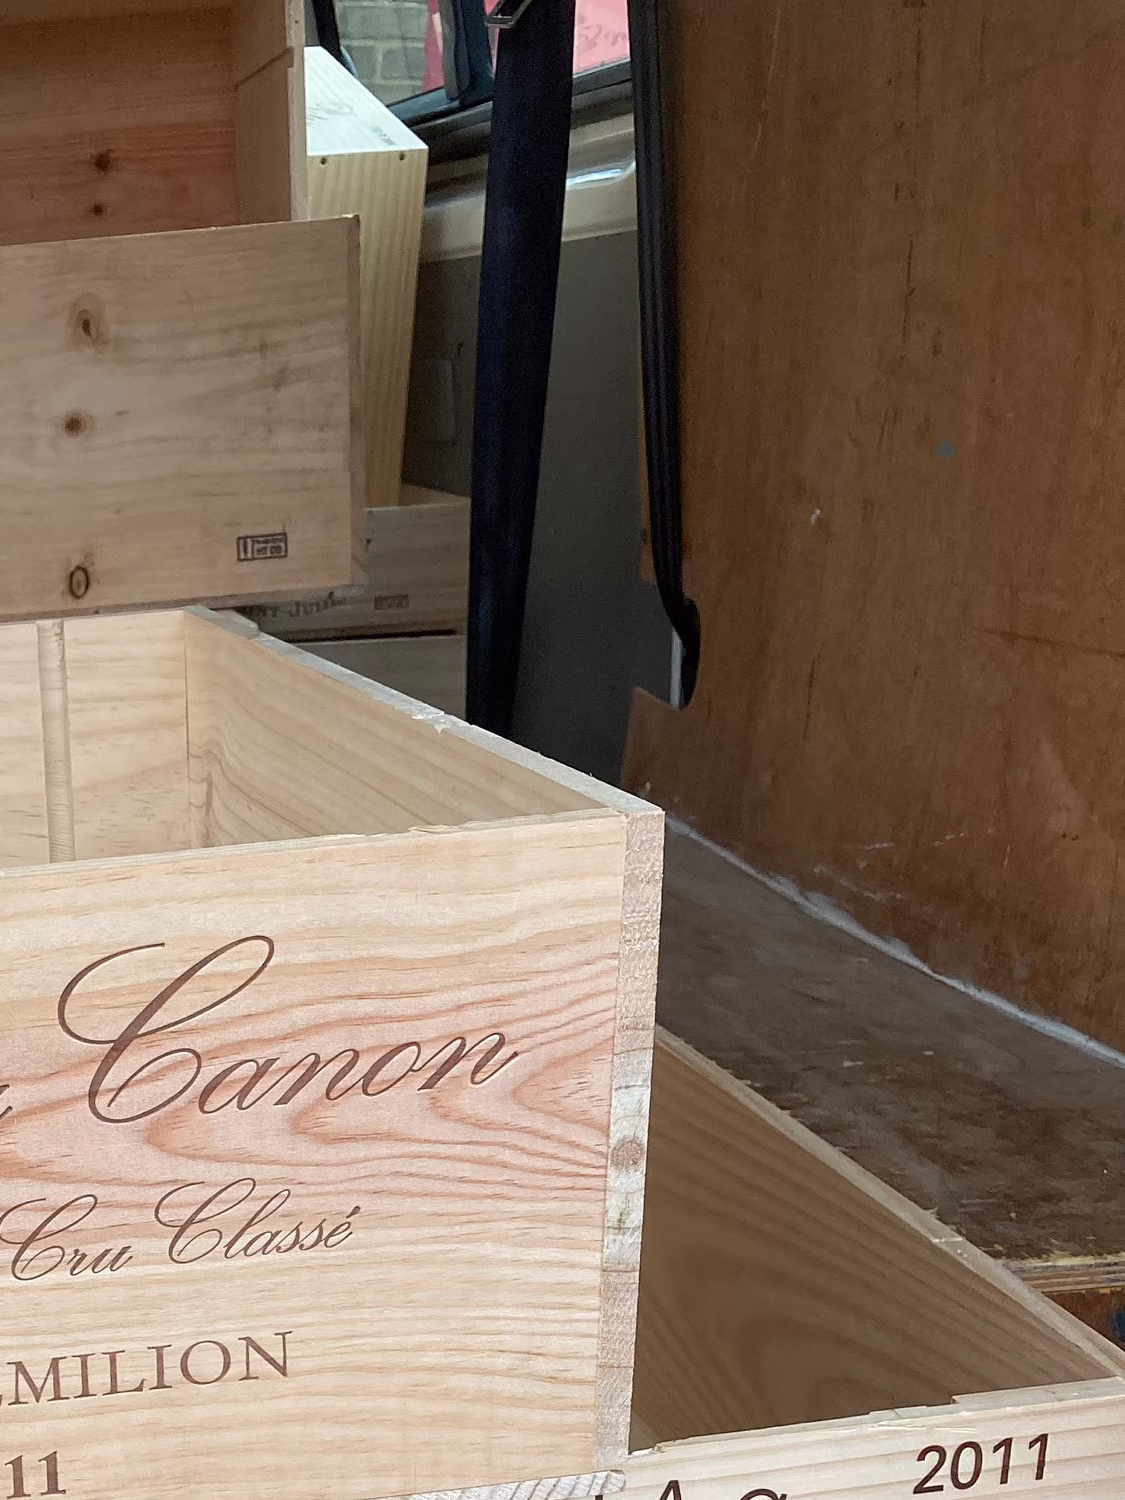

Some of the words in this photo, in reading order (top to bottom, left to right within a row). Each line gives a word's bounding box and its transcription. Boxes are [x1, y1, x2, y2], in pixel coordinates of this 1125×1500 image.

[57, 935, 518, 1124] Canon
[154, 1177, 360, 1264] Classé
[912, 1433, 1050, 1495] 2011
